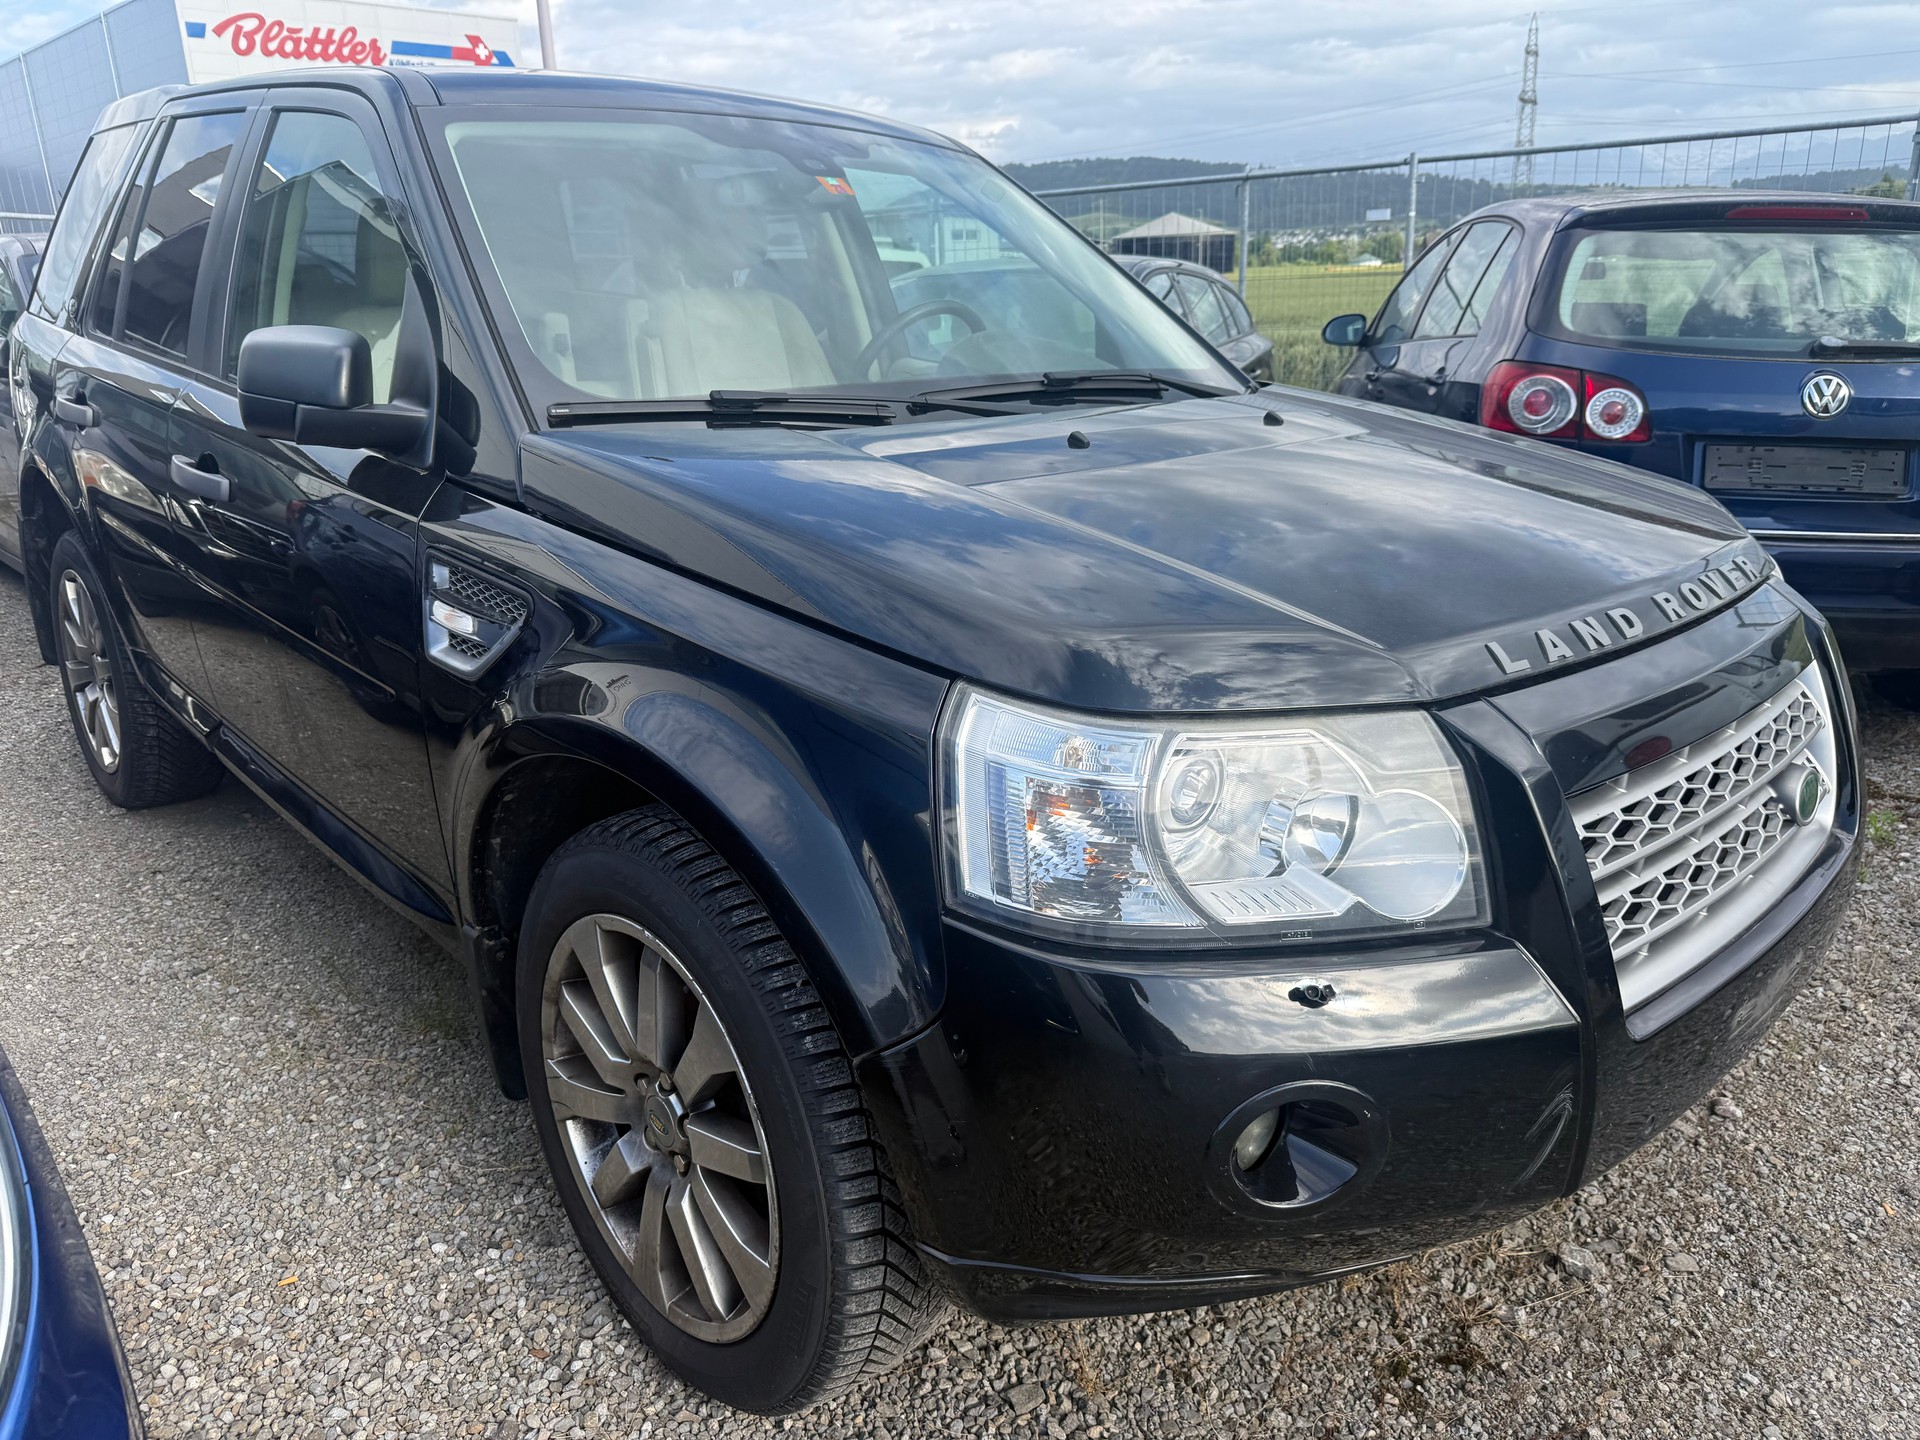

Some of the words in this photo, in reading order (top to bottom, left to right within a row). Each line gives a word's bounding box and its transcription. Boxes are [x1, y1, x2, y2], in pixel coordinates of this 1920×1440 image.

[212, 13, 386, 65] Blättler
[1485, 607, 1644, 674] LAND
[1652, 555, 1762, 622] ROVER
